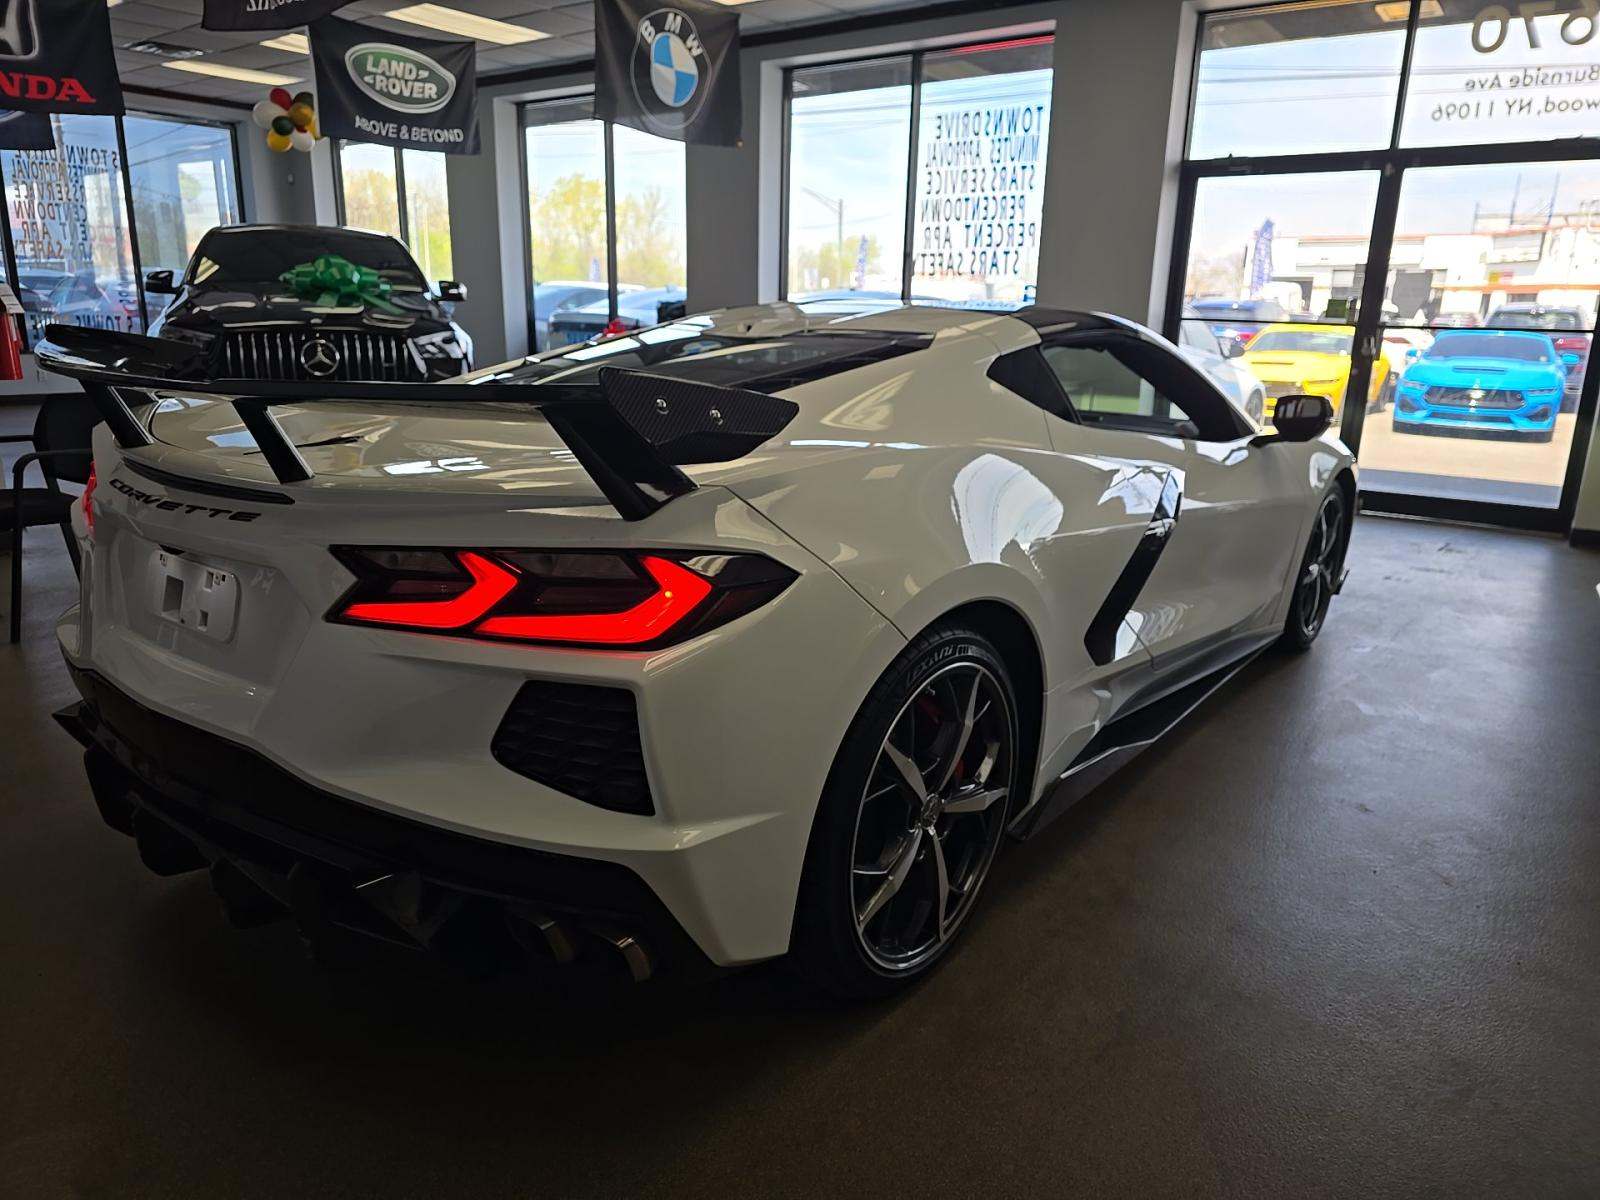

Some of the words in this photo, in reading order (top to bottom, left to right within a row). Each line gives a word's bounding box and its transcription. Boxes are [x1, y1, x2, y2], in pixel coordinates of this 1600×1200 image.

[640, 12, 704, 56] BMW
[366, 54, 418, 80] LAND
[374, 75, 438, 99] ROVER
[354, 115, 398, 138] ABOVE
[399, 125, 410, 140] &
[411, 127, 464, 143] BEYOND
[109, 478, 262, 522] CORVETTE
